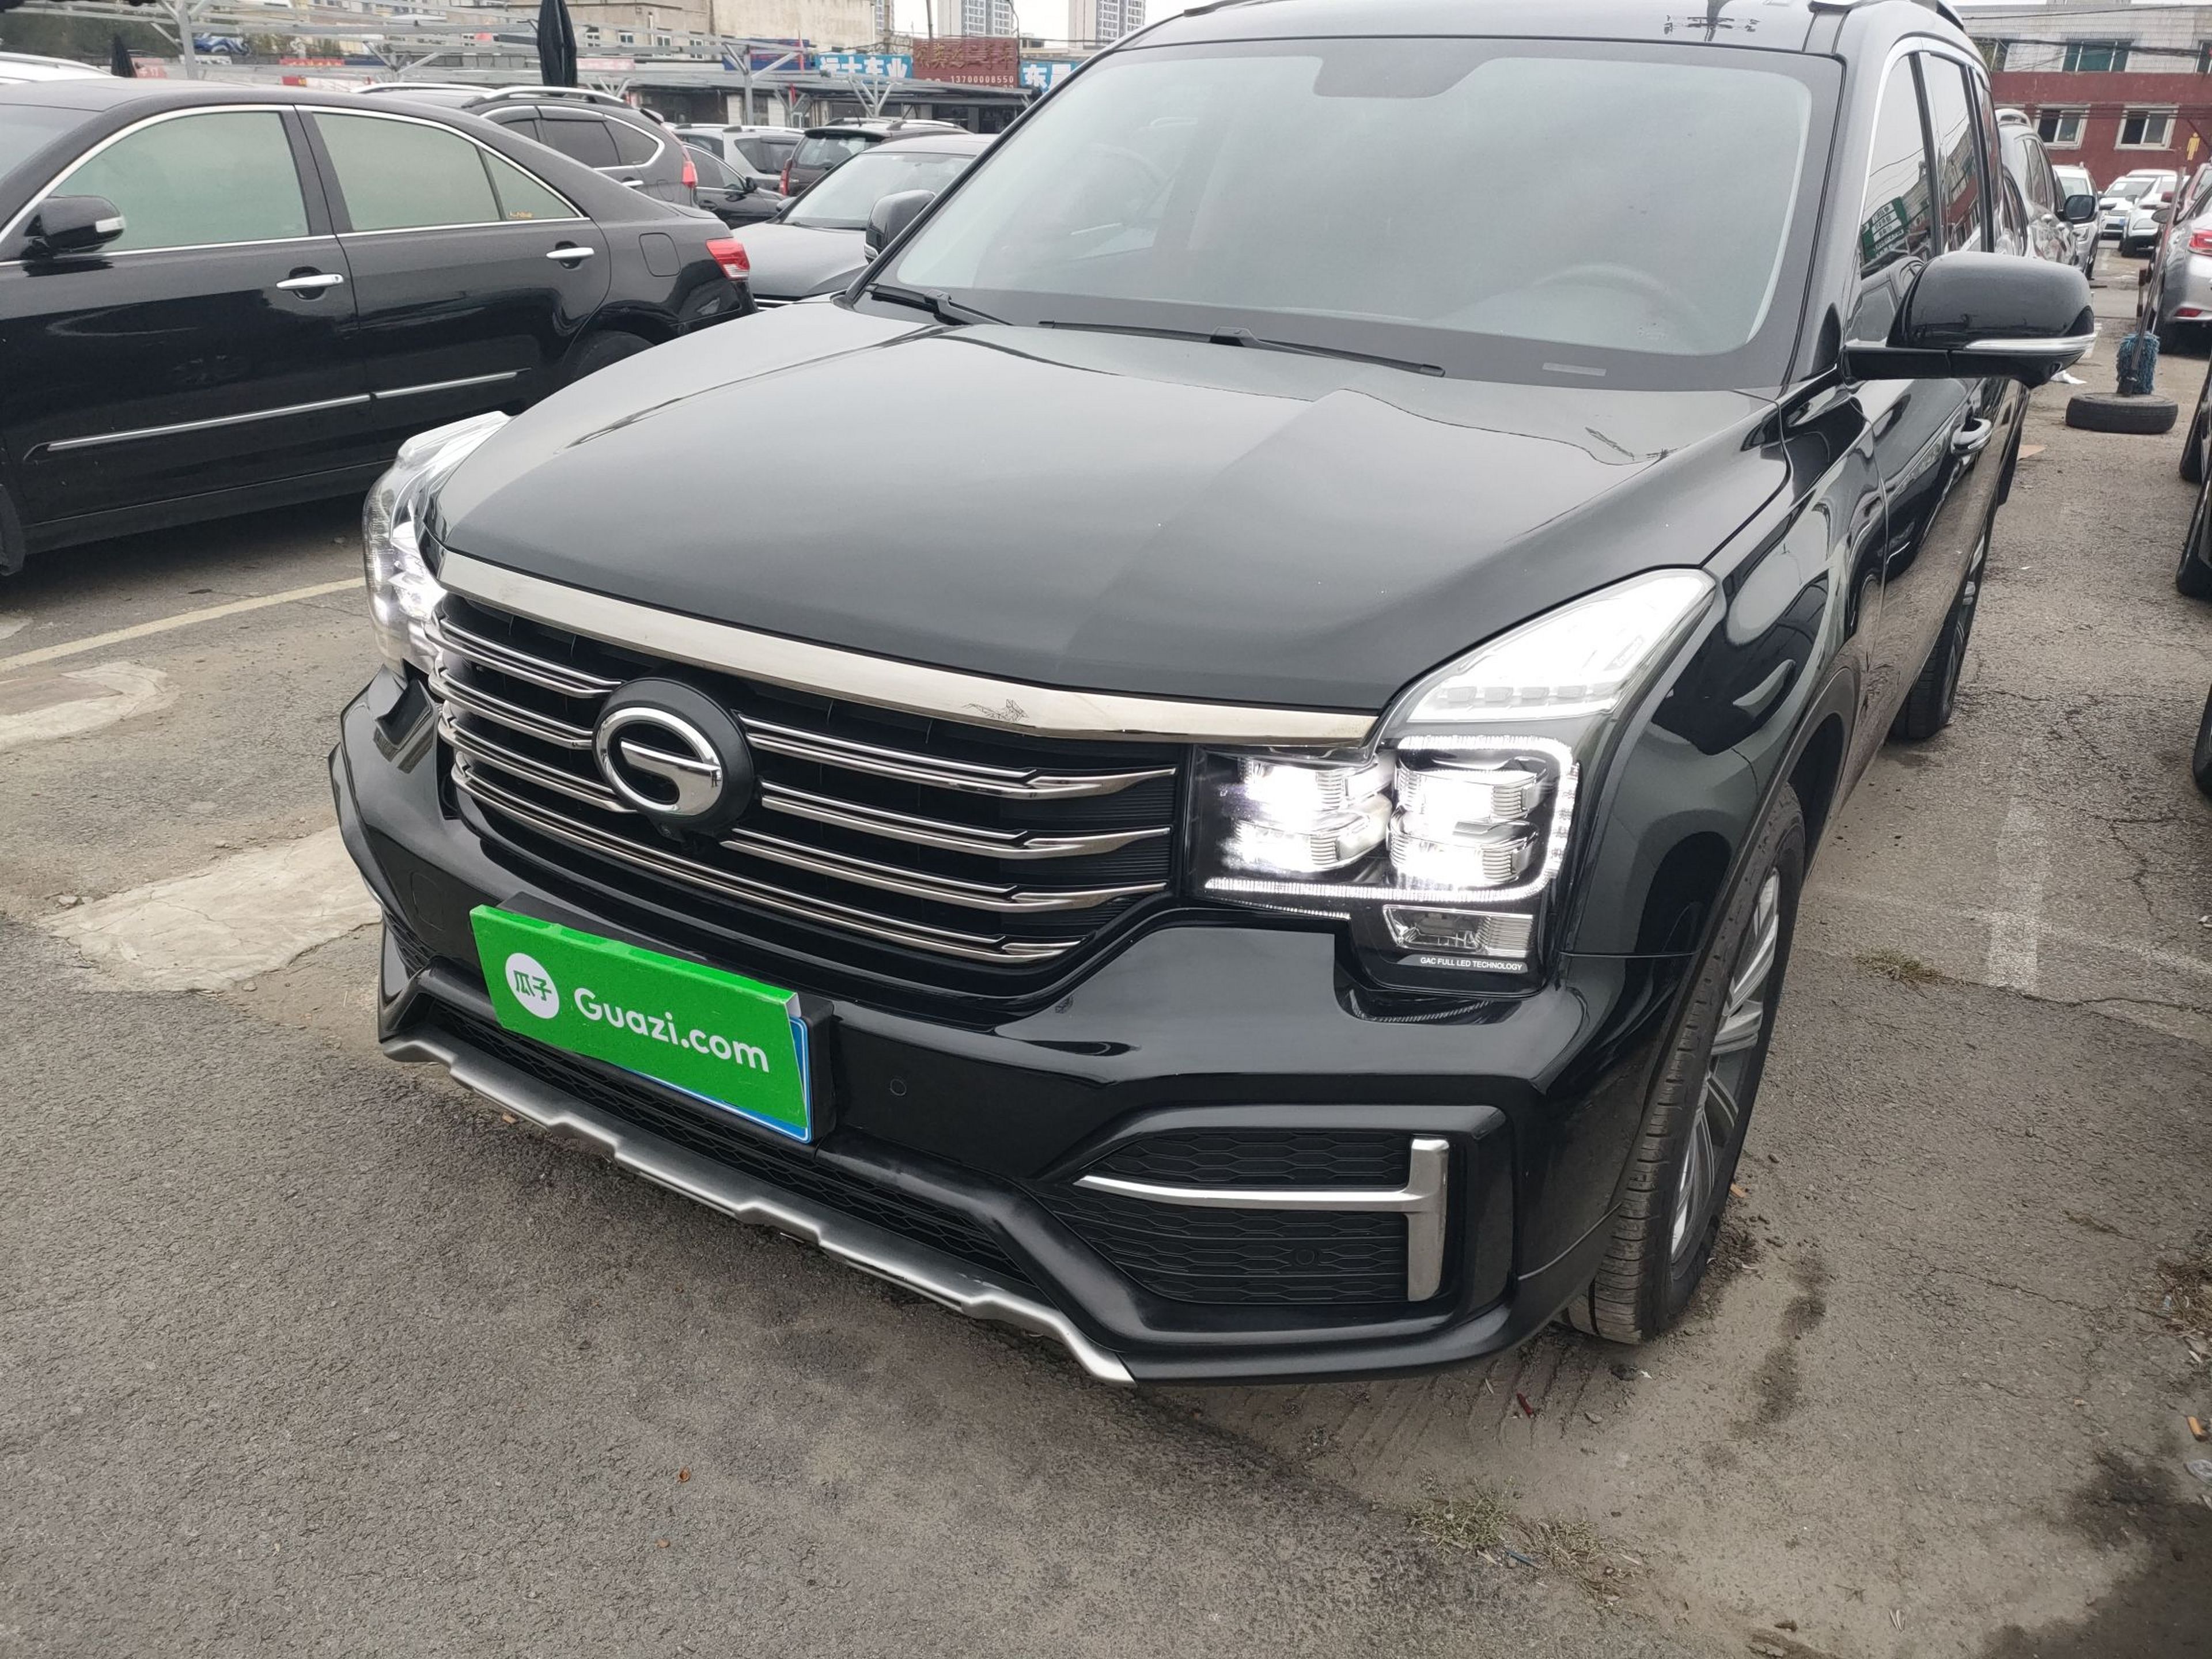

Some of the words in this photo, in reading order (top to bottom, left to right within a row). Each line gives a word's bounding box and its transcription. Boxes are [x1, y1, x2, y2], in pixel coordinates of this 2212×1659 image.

[950, 75, 1014, 84] 13700008550
[1420, 957, 1436, 965] GAC
[1437, 958, 1455, 966] FULL
[1472, 961, 1522, 971] TECHNOLOGY
[513, 969, 552, 1002] 瓜子
[574, 987, 770, 1073] Guazi.com
